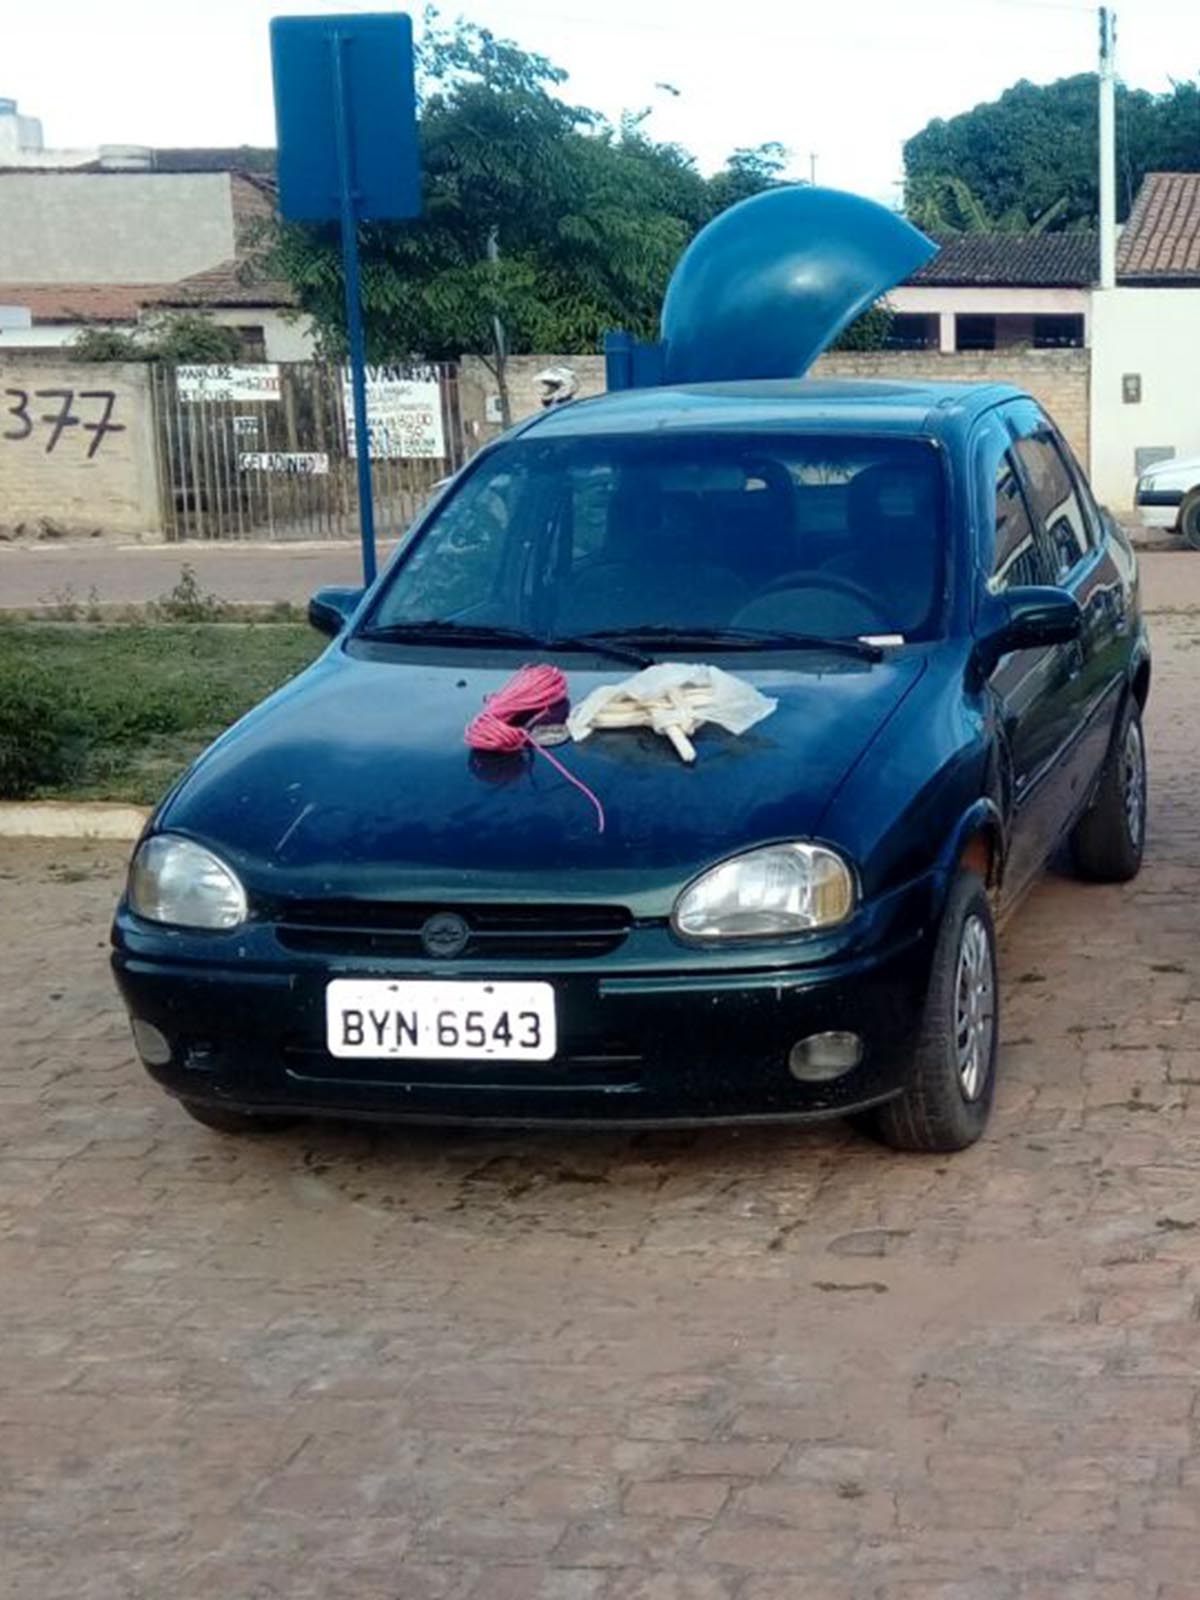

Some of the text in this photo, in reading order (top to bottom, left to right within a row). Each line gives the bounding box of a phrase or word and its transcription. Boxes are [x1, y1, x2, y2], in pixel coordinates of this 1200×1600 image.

[4, 388, 127, 459] 377
[341, 1009, 541, 1048] BYN 6543
